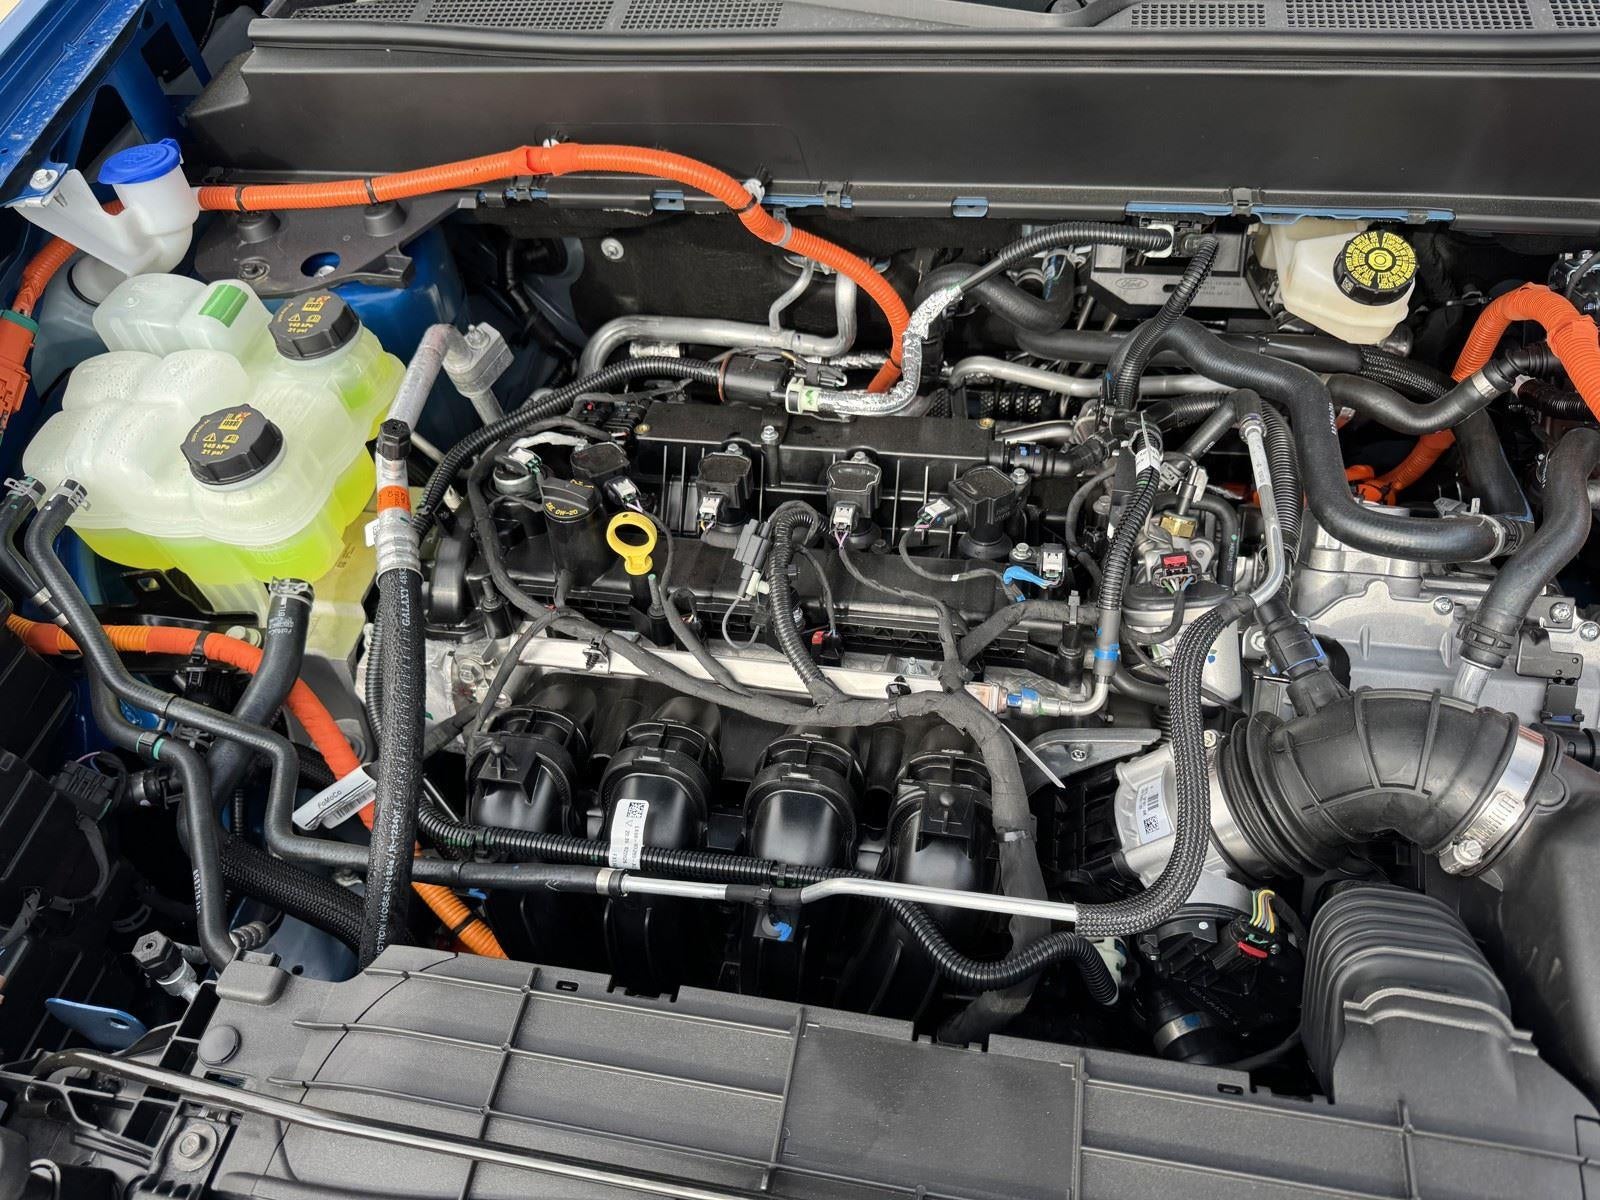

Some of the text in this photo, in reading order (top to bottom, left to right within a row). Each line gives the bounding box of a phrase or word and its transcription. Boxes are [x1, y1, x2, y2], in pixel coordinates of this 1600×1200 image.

[400, 586, 411, 627] GALAXY
[317, 790, 343, 809] FoMoCo
[379, 895, 391, 921] HOSE
[376, 924, 387, 954] CTION
